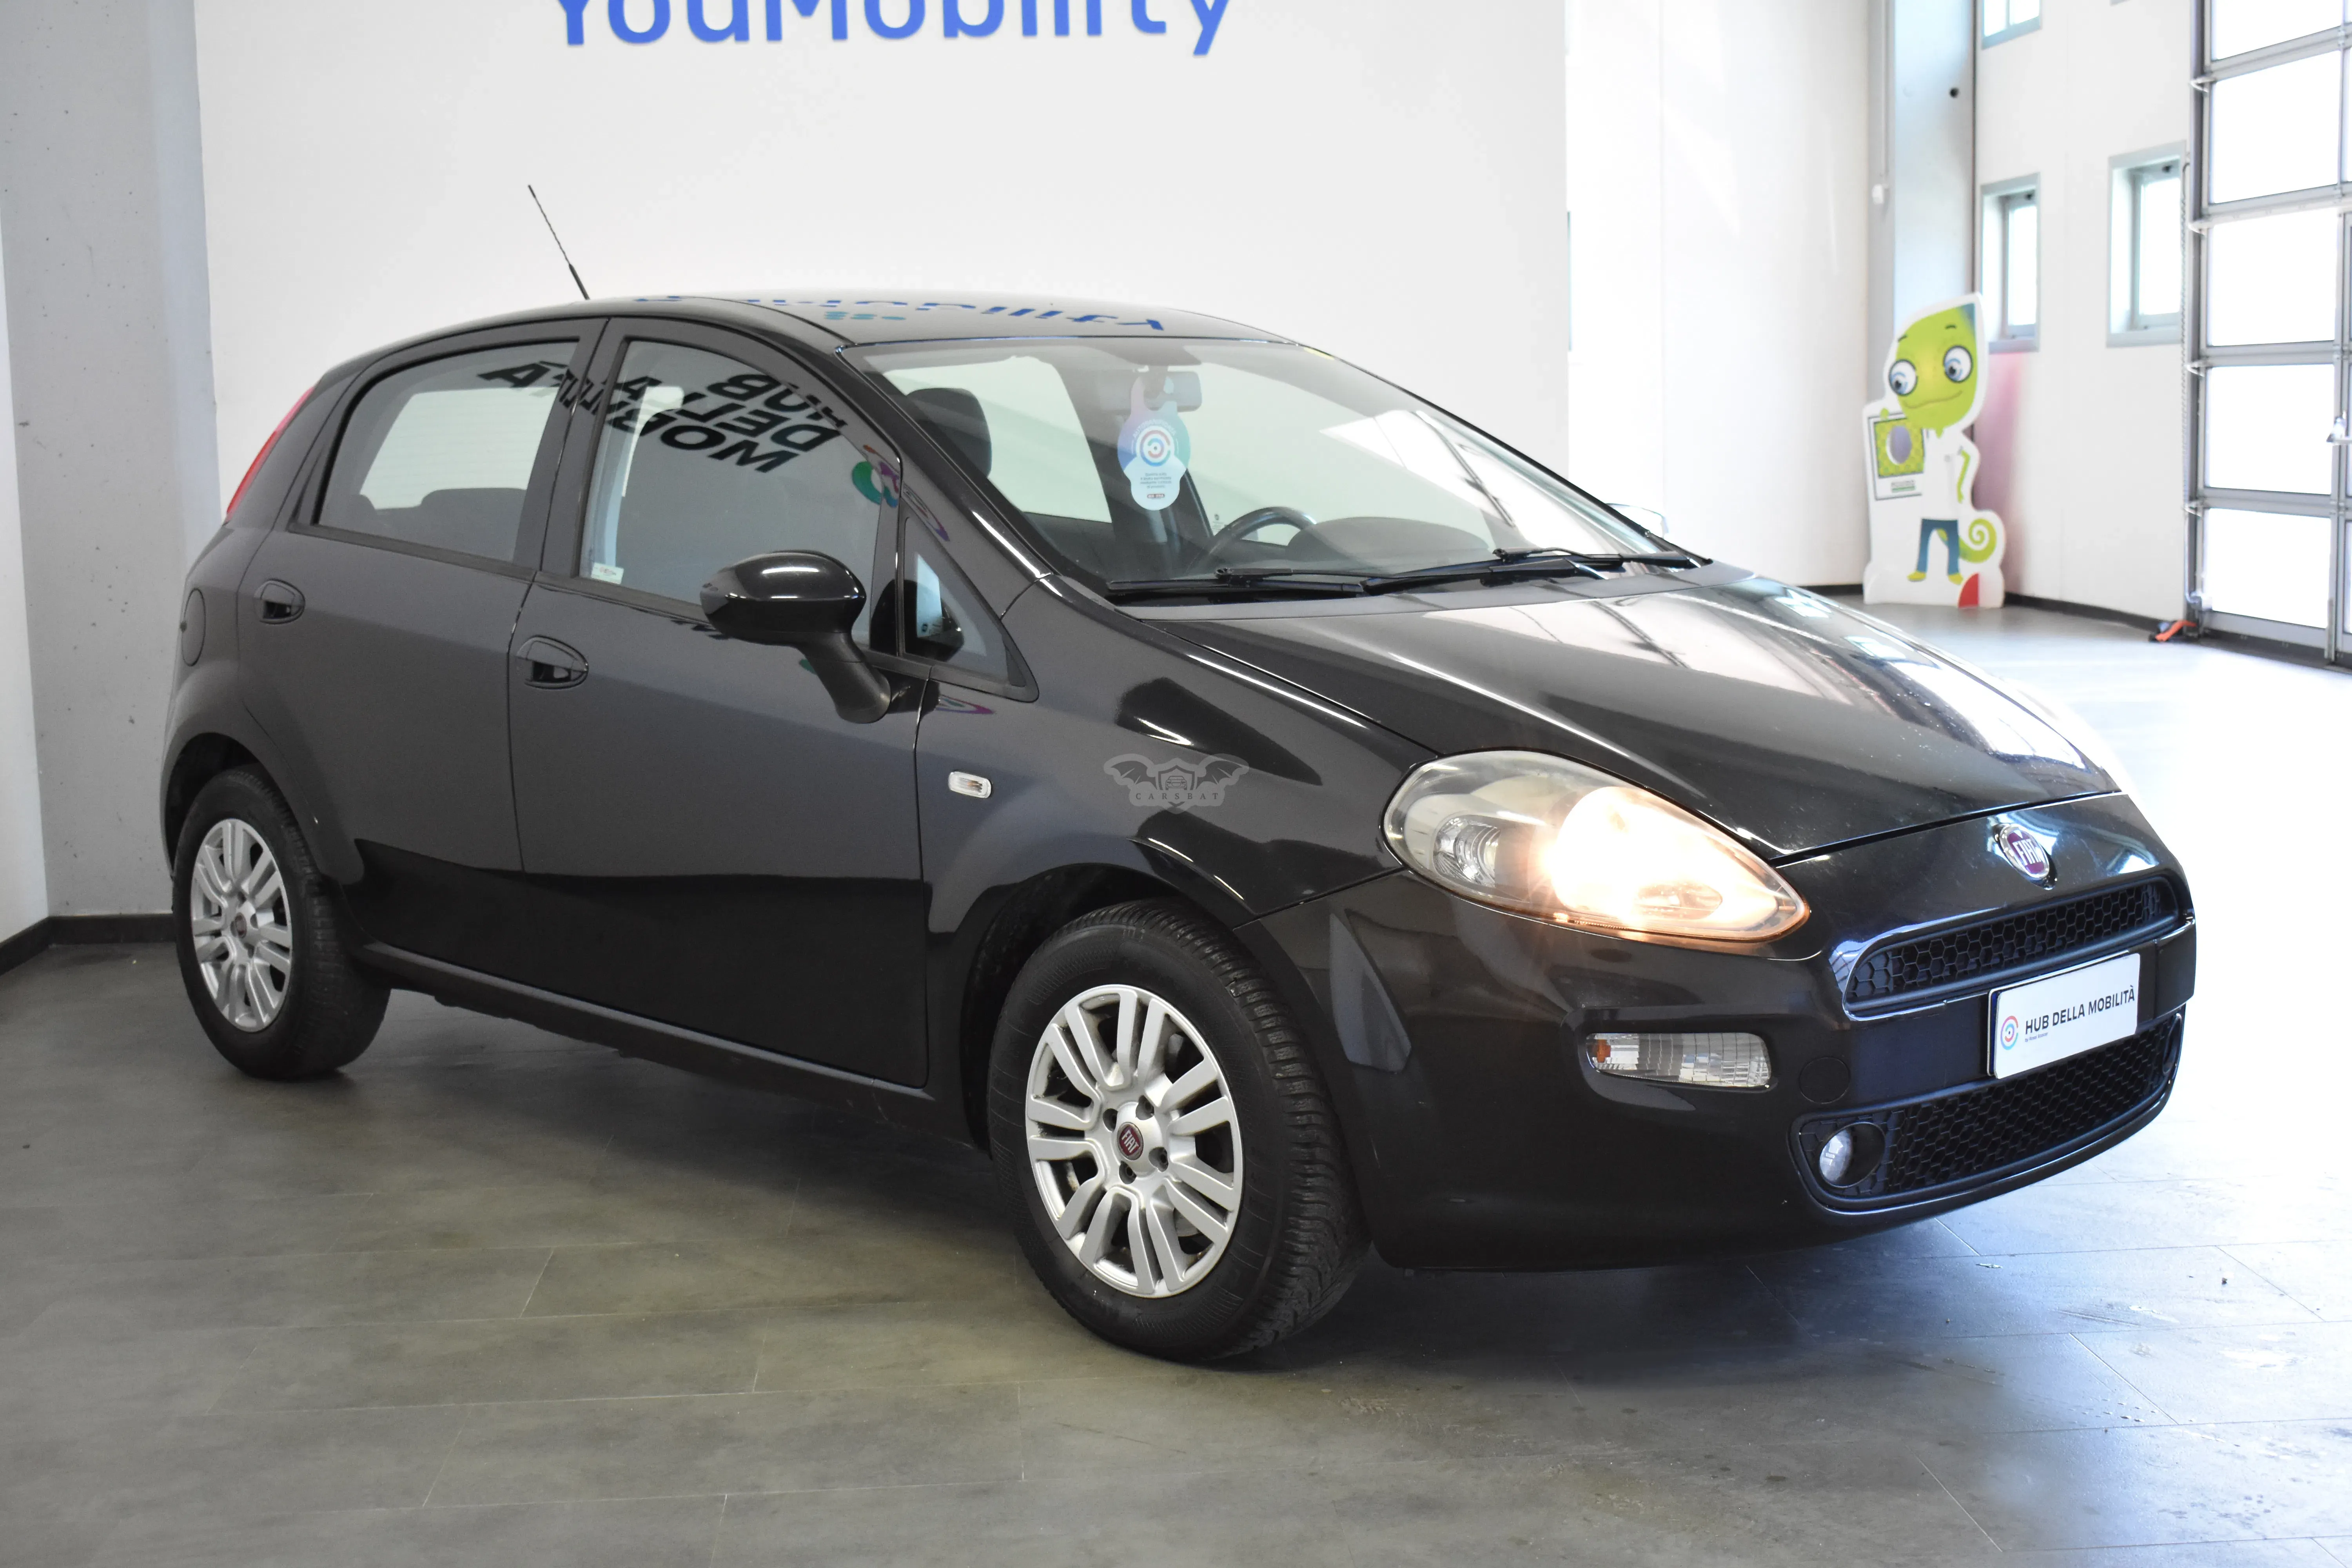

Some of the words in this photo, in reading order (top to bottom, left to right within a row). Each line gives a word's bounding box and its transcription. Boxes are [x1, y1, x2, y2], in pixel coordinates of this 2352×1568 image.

[2012, 838, 2042, 866] FIAT
[2025, 1015, 2049, 1034] HUB
[2052, 1004, 2085, 1026] DELLA
[2088, 985, 2135, 1015] MOBILITÀ
[1122, 1130, 1139, 1153] FIAT
